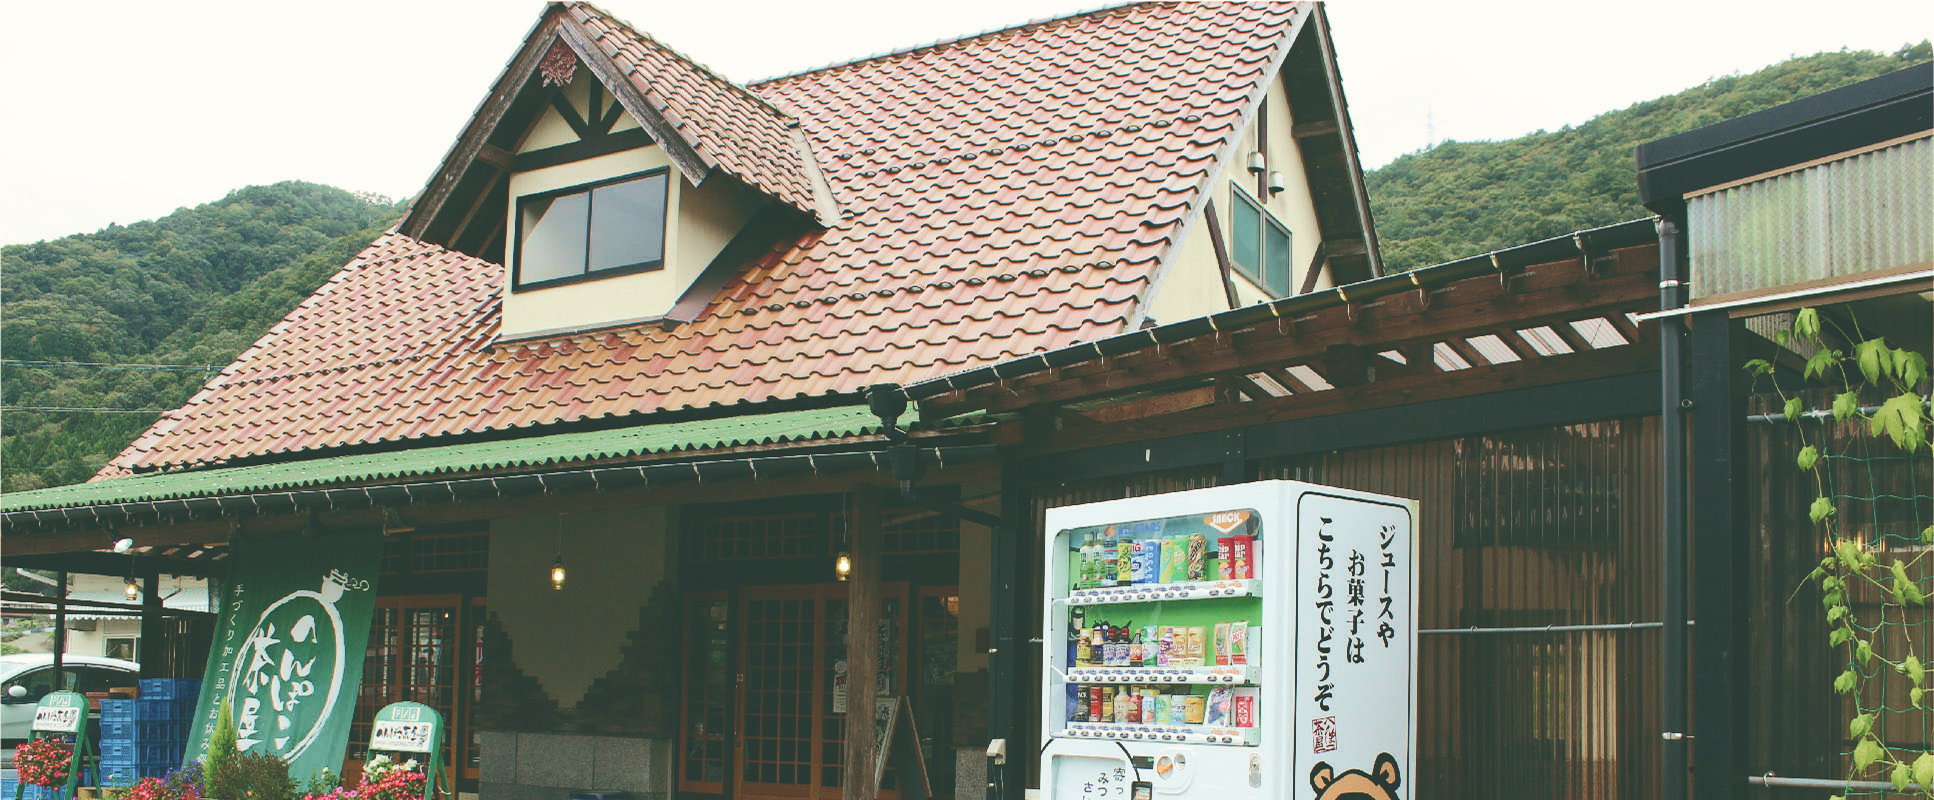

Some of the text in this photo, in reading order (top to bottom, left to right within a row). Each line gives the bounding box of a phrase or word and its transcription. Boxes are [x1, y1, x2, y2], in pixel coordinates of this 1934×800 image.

[1212, 512, 1240, 524] SNACK
[1314, 516, 1335, 711] こちらでどうぞ
[1347, 549, 1365, 664] お菓子は
[1376, 524, 1396, 648] ジュースや
